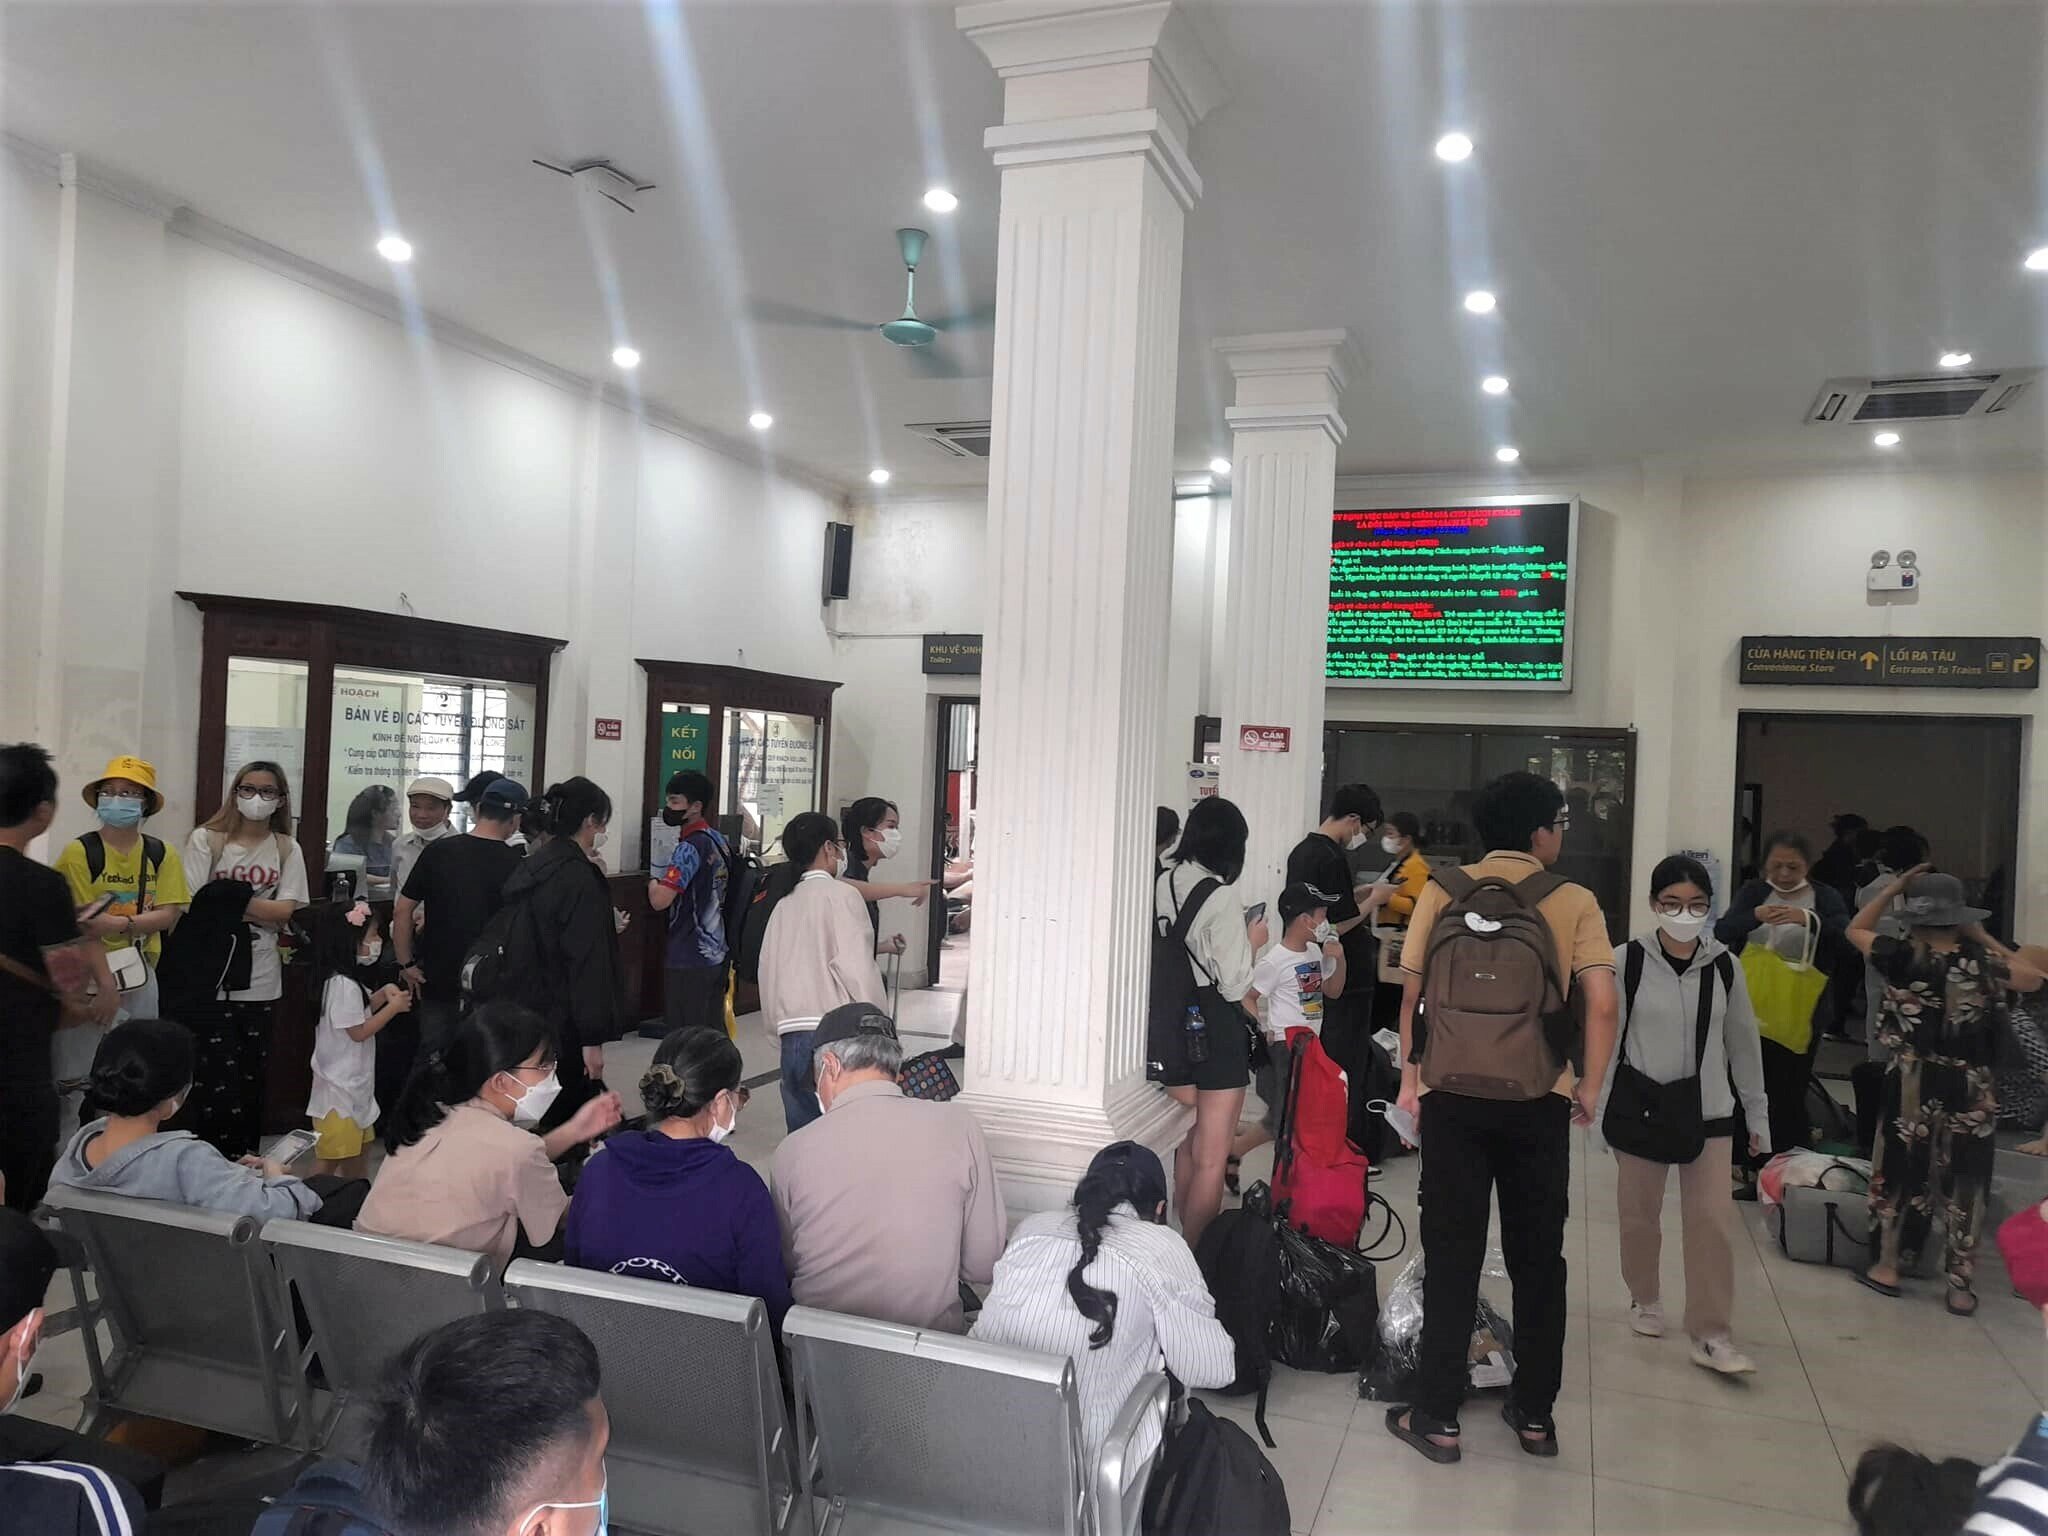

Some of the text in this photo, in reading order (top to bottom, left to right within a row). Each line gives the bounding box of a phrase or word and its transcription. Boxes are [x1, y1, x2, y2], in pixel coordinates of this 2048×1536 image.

[1912, 650, 1928, 662] RA
[1810, 664, 1836, 672] Store
[1890, 664, 1934, 674] Entrance
[1938, 666, 1948, 674] To
[345, 704, 370, 721] BÁN
[374, 706, 388, 723] VÉ
[672, 724, 699, 738] KẾT
[672, 746, 696, 760] NỐI
